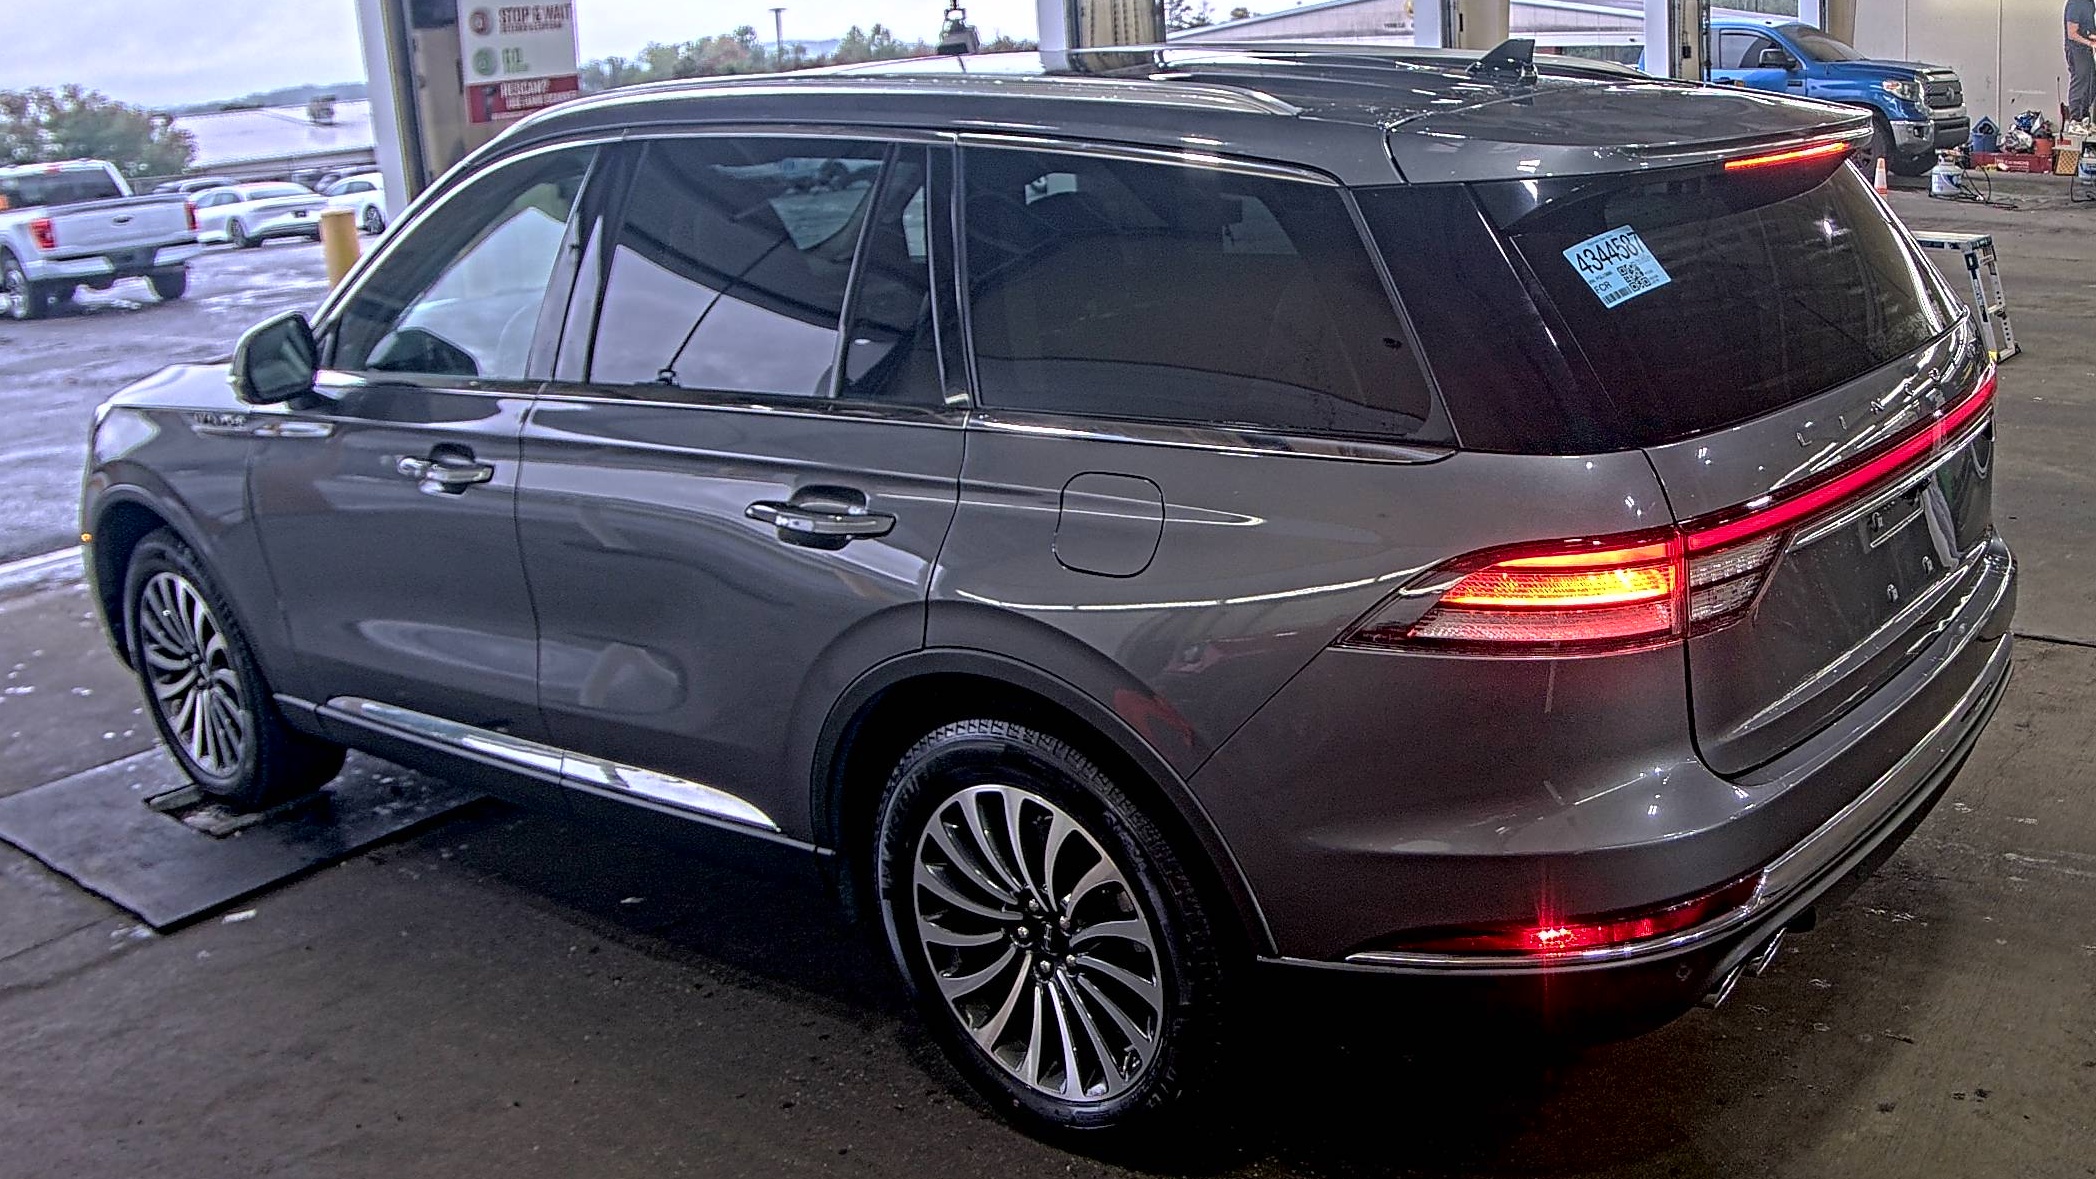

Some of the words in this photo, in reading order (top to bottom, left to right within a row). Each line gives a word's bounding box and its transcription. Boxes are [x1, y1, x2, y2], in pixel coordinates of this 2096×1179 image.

[499, 6, 529, 23] STOP
[545, 3, 572, 20] WAIT
[1575, 231, 1645, 275] 4344587
